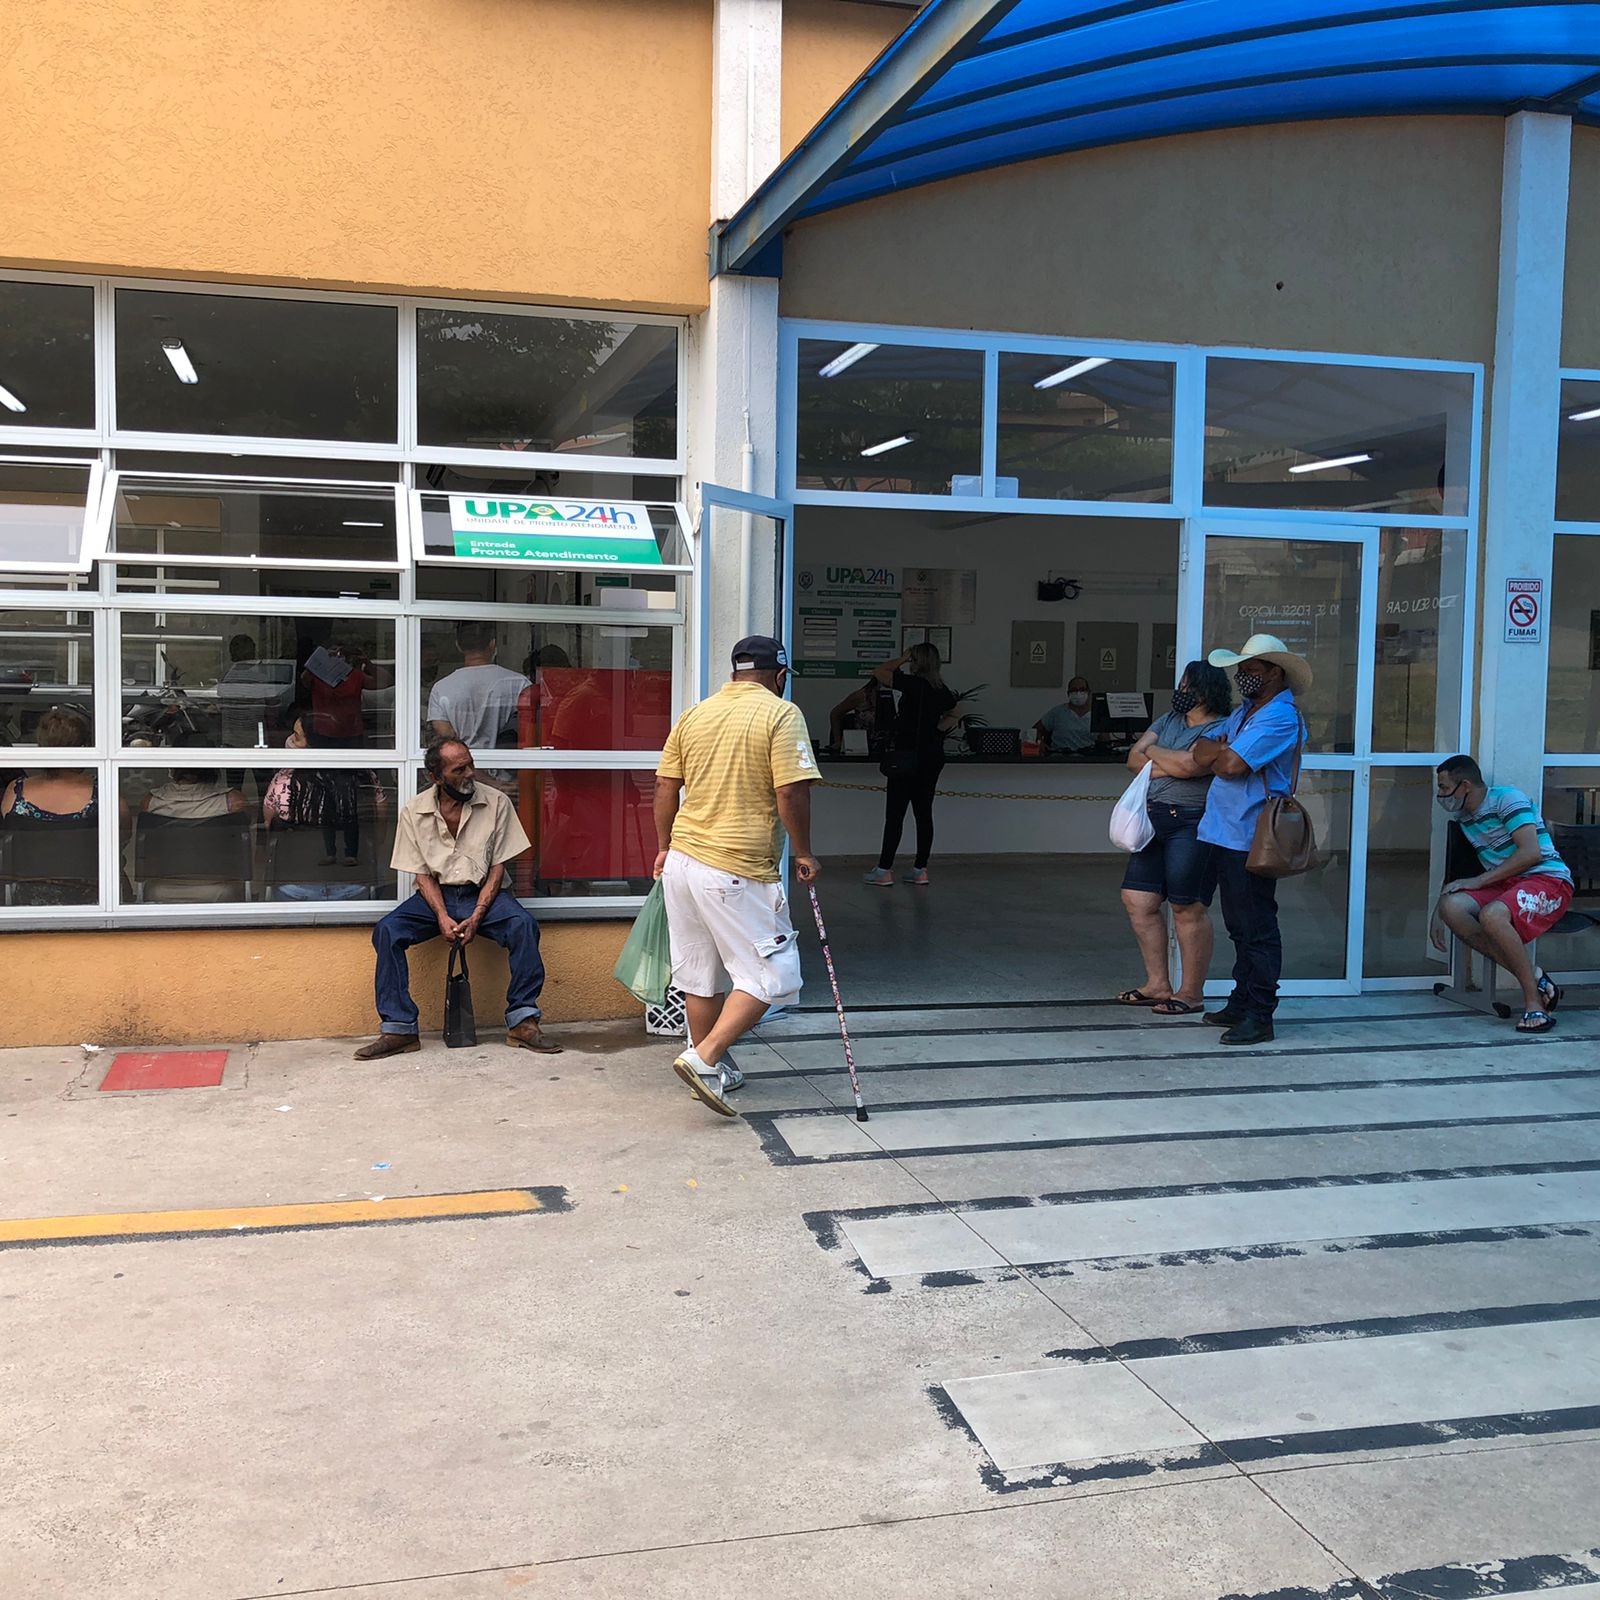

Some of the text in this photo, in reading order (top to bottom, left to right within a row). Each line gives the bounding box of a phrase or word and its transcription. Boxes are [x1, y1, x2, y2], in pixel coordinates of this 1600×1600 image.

[466, 517, 510, 525] UNIDADE
[529, 520, 569, 528] PRONTO
[570, 523, 638, 531] ATENDIMENTO
[470, 540, 516, 549] Entrada
[471, 547, 619, 561] Pronto Atendimento
[1510, 582, 1539, 591] PROIBIDO
[1509, 628, 1536, 636] FUMAR
